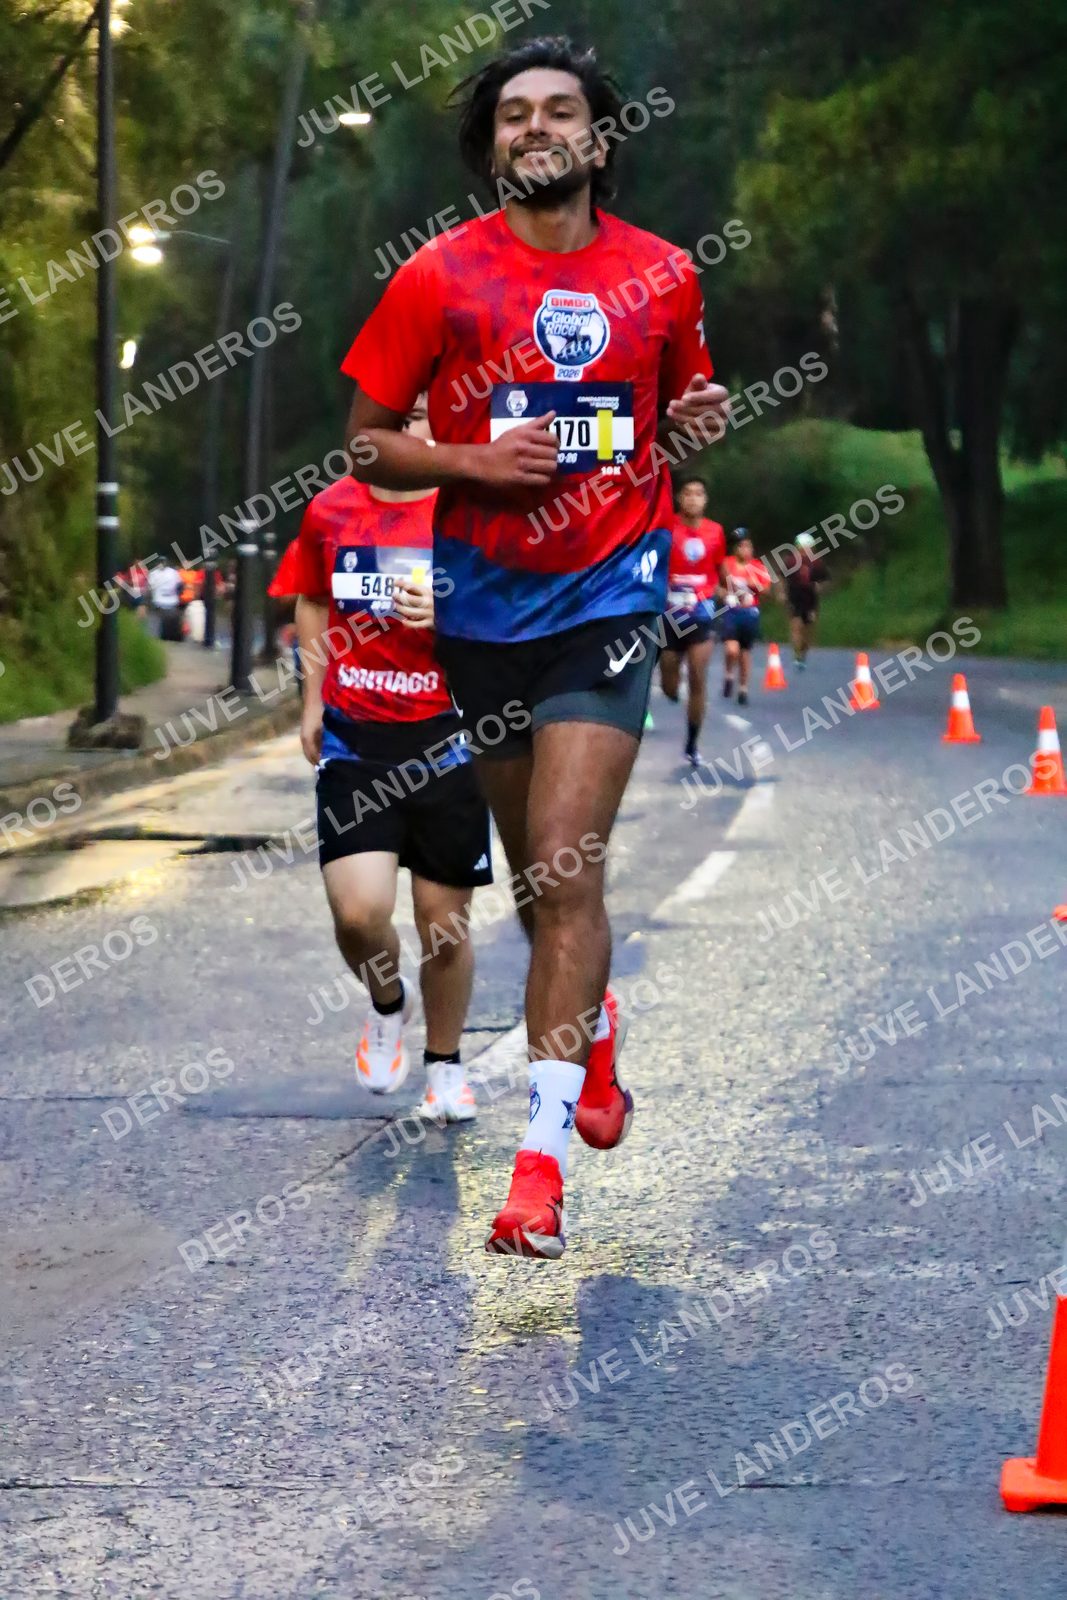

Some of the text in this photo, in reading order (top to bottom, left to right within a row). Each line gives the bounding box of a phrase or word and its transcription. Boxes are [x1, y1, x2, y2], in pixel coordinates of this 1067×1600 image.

[552, 311, 590, 327] Global
[545, 321, 577, 336] Race
[338, 663, 439, 695] SANTIAGO
